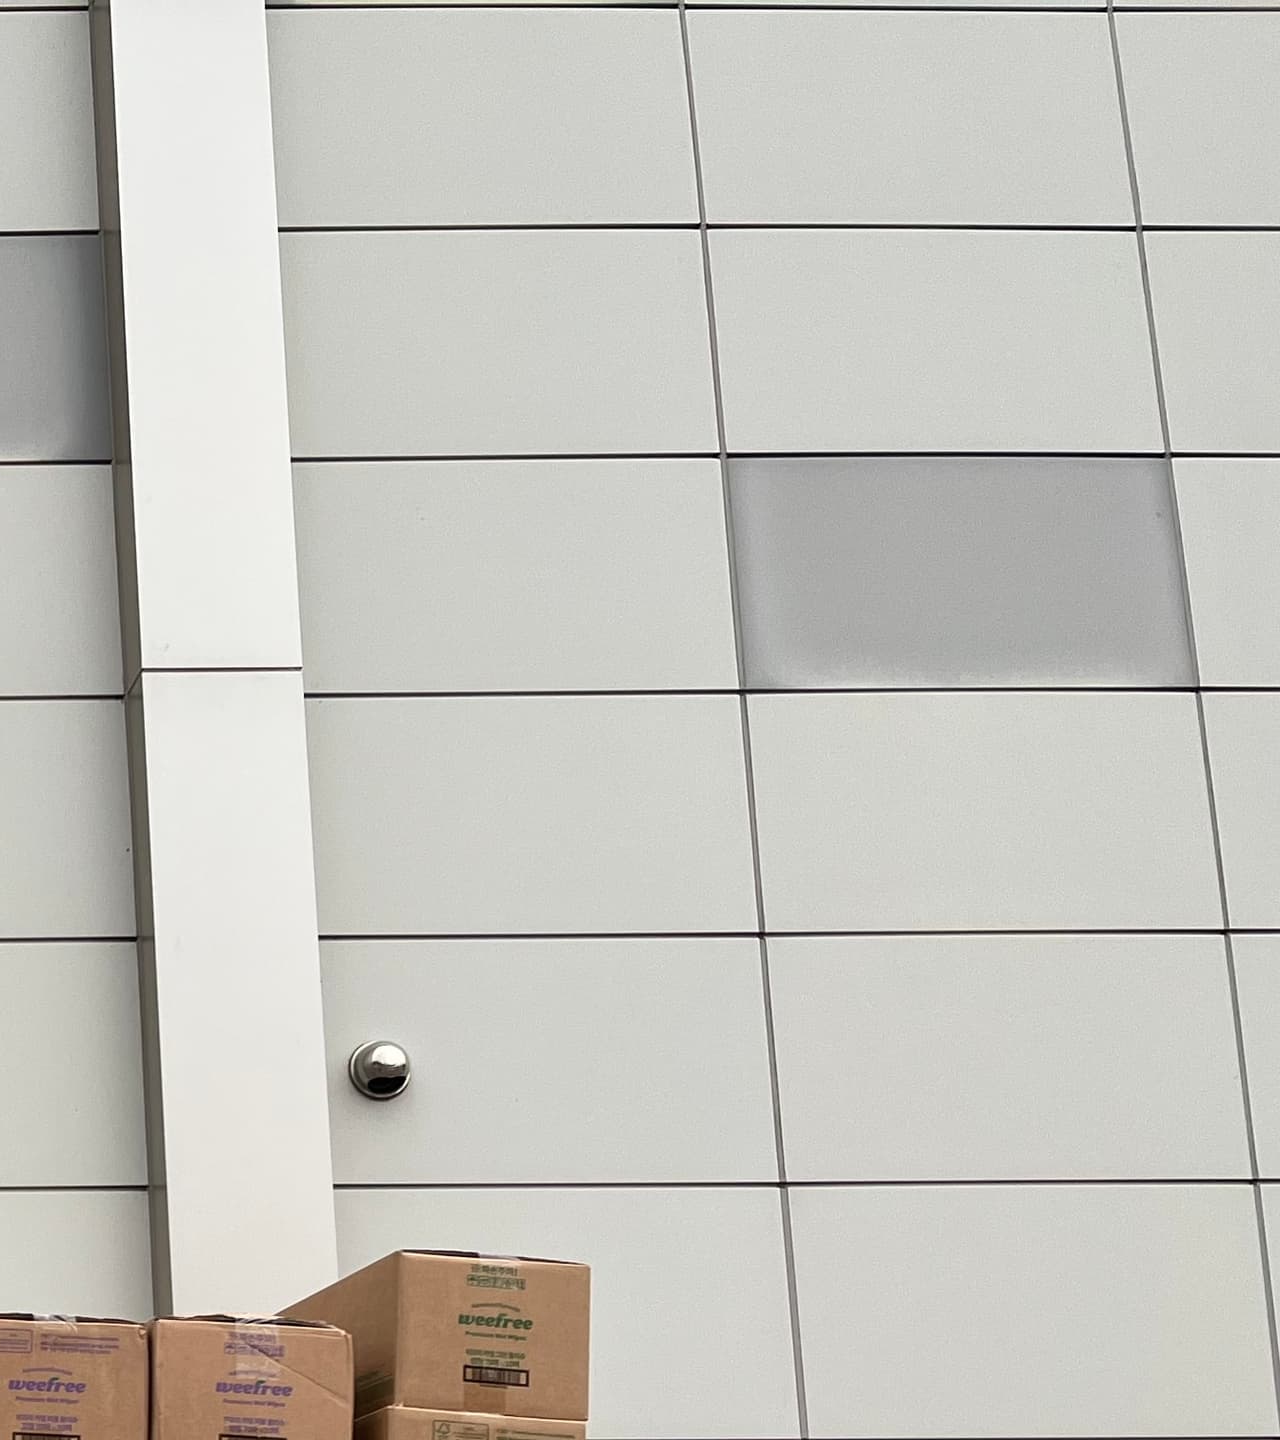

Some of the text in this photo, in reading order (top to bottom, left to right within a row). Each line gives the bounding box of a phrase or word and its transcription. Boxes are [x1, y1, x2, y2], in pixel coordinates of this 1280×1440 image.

[458, 1313, 533, 1328] weefree
[8, 1377, 86, 1394] weefree
[216, 1380, 293, 1395] weefree
